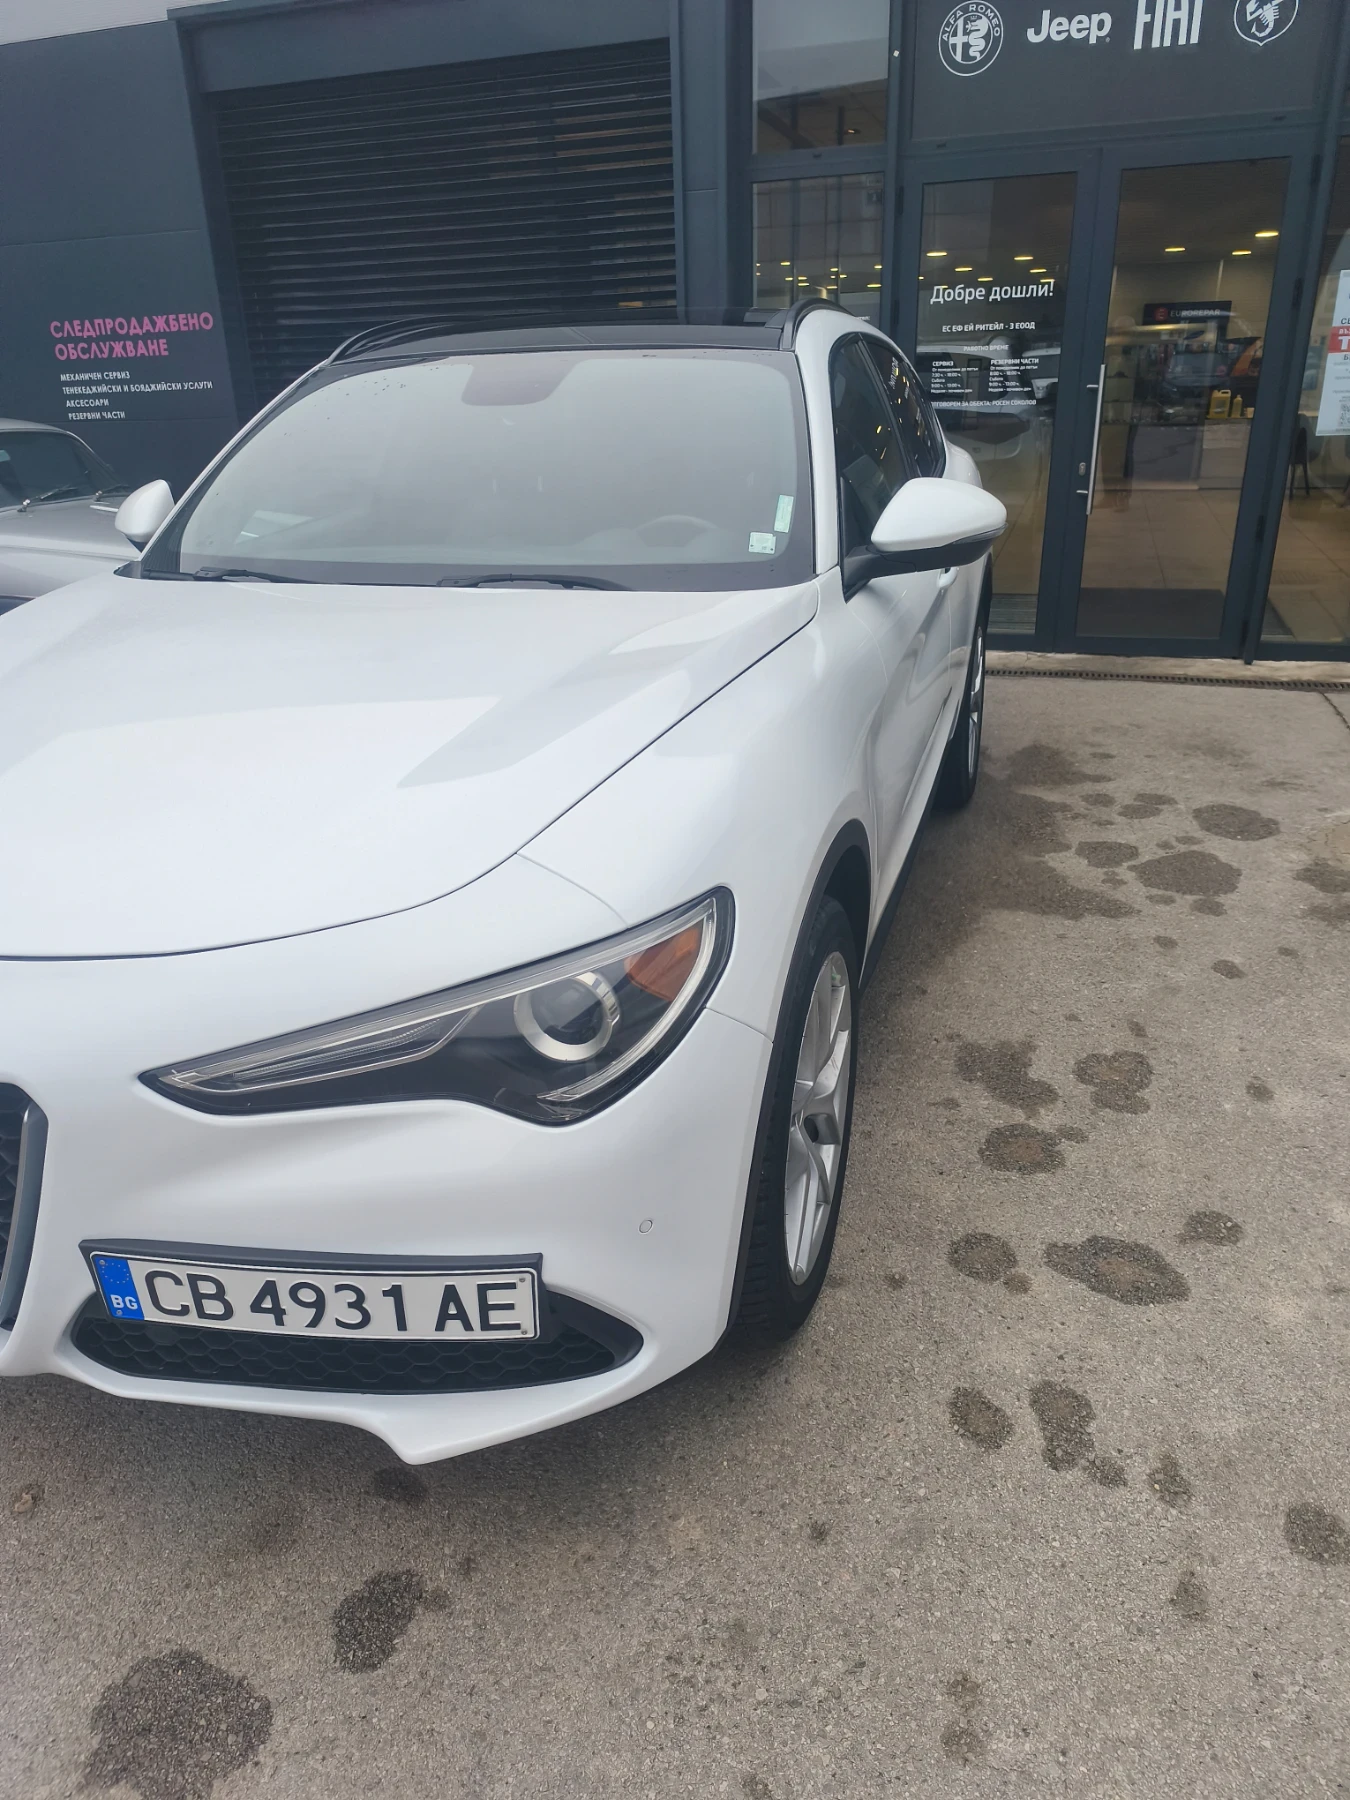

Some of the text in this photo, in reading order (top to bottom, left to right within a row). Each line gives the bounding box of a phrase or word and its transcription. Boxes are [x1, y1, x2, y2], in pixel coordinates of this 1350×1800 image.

[942, 4, 1000, 41] ALFA ROMEO
[1027, 10, 1112, 44] Jeep
[930, 280, 1055, 304] Добре дошли!
[50, 312, 213, 338] СЛЕДПРОДАЖБЕНО
[942, 325, 951, 333] ЕС
[964, 323, 974, 331] ЕЙ
[975, 322, 1004, 331] РИТЕЙЛ
[1015, 322, 1035, 330] ЕООД
[55, 339, 169, 360] ОБСЛУЖВАНЕ
[60, 371, 130, 382] МЕХАНИЧЕН СЕРВИЗ
[62, 381, 213, 394] ТЕНЕКЕДЖИЙСКИ И БОЯДЖИЙСКИ УСЛУГИ
[66, 399, 109, 408] АКСЕСОАРИ
[68, 411, 125, 420] РЕЗЕРВНИ ЧАСТИ
[111, 1295, 138, 1311] BG
[145, 1269, 523, 1332] CB 4931 AE
